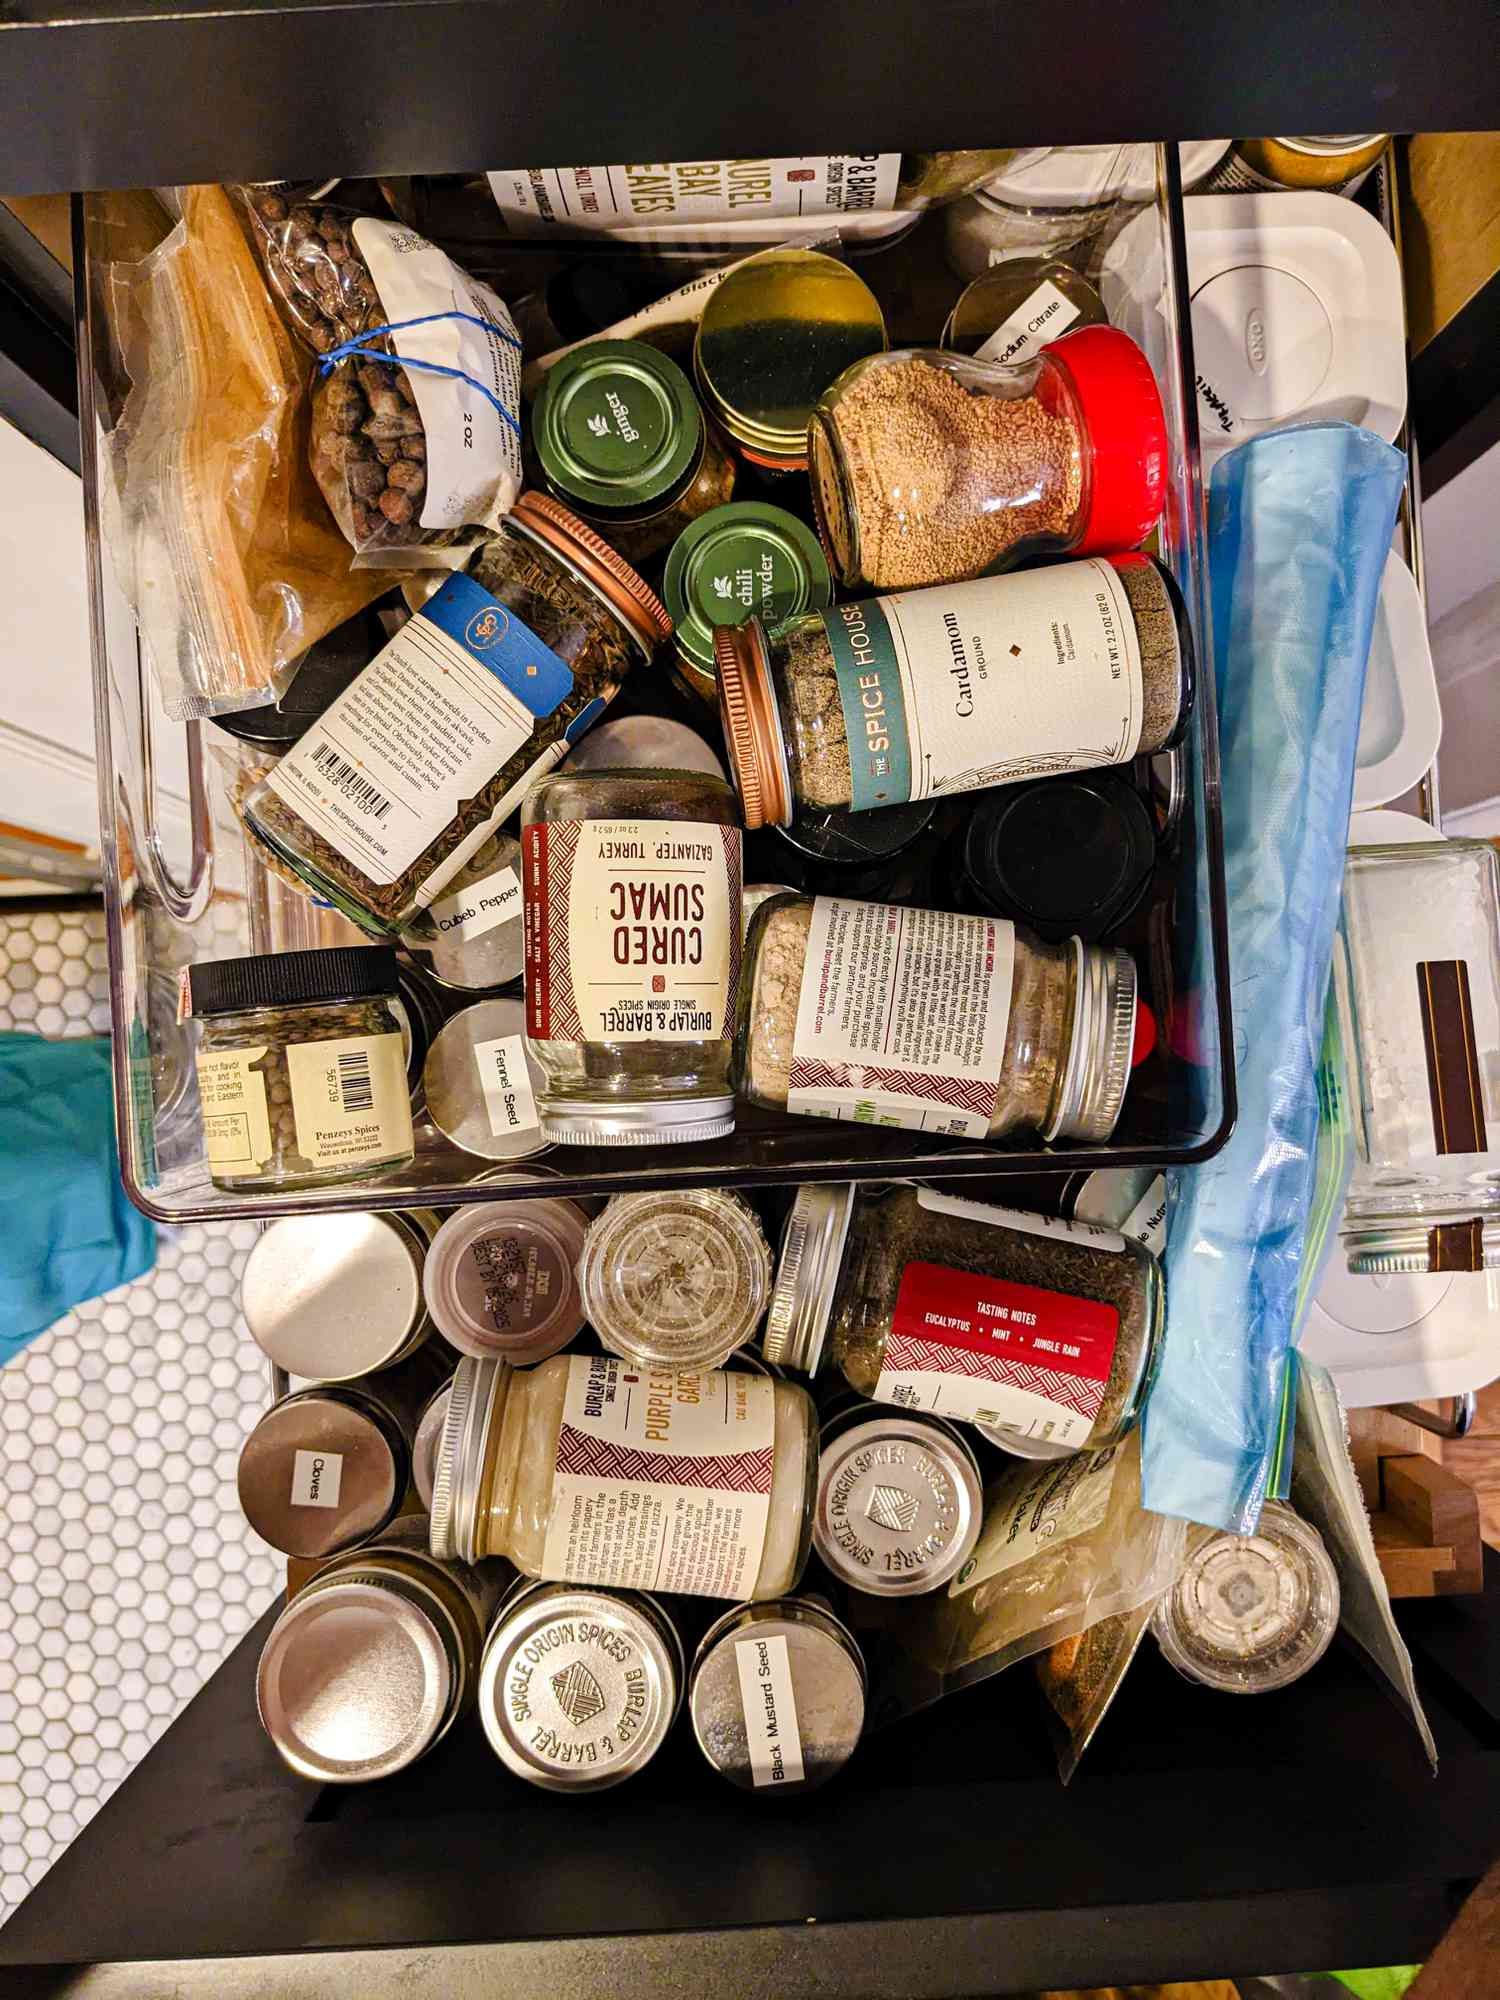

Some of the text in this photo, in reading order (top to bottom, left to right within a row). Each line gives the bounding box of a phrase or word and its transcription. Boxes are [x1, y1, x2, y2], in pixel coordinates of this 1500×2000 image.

[622, 163, 677, 214] EAVES
[1027, 301, 1060, 333] Citrate
[462, 411, 473, 449] 2 OZ
[603, 390, 642, 445] ginger
[735, 567, 755, 608] chili
[758, 551, 776, 625] powder
[1050, 621, 1065, 665] Ingredients:
[1101, 615, 1113, 628] OZ
[1103, 628, 1117, 644] 2.2
[943, 612, 973, 717] Cardamom
[971, 635, 988, 680] GROUND
[1109, 662, 1121, 680] NET
[842, 605, 889, 777] THE SPICE HOUSE
[314, 759, 341, 786] 16328
[339, 783, 373, 815] 02100
[598, 841, 713, 861] GAZIANTEP, TURKEY
[438, 884, 520, 933] Cubeb Pepper
[610, 881, 704, 921] SUMAC
[612, 925, 702, 965] CURED
[600, 1006, 712, 1032] BURLAP & BARREL
[617, 998, 697, 1011] SINGLE ORIGIN SPICES
[325, 1068, 340, 1103] 56739
[493, 1047, 521, 1128] Fennel Seed
[314, 1123, 380, 1141] Penzeys Spices
[924, 1311, 1080, 1357] EUCALYPTUS MINT JUNGLE RAIN
[976, 1301, 1037, 1326] TASTING NOTES
[583, 1372, 606, 1417] BURLAP &
[644, 1382, 673, 1441] PURPLE
[308, 1457, 325, 1501] Cloves
[854, 1445, 906, 1473] SPICES
[830, 1464, 859, 1517] ORIGIN
[832, 1518, 875, 1566] SINGLE
[509, 1621, 646, 1763] SINGLE ORIGIN SPICES BURLAP & BARREL
[757, 1639, 786, 1782] Black Mustard Seed
